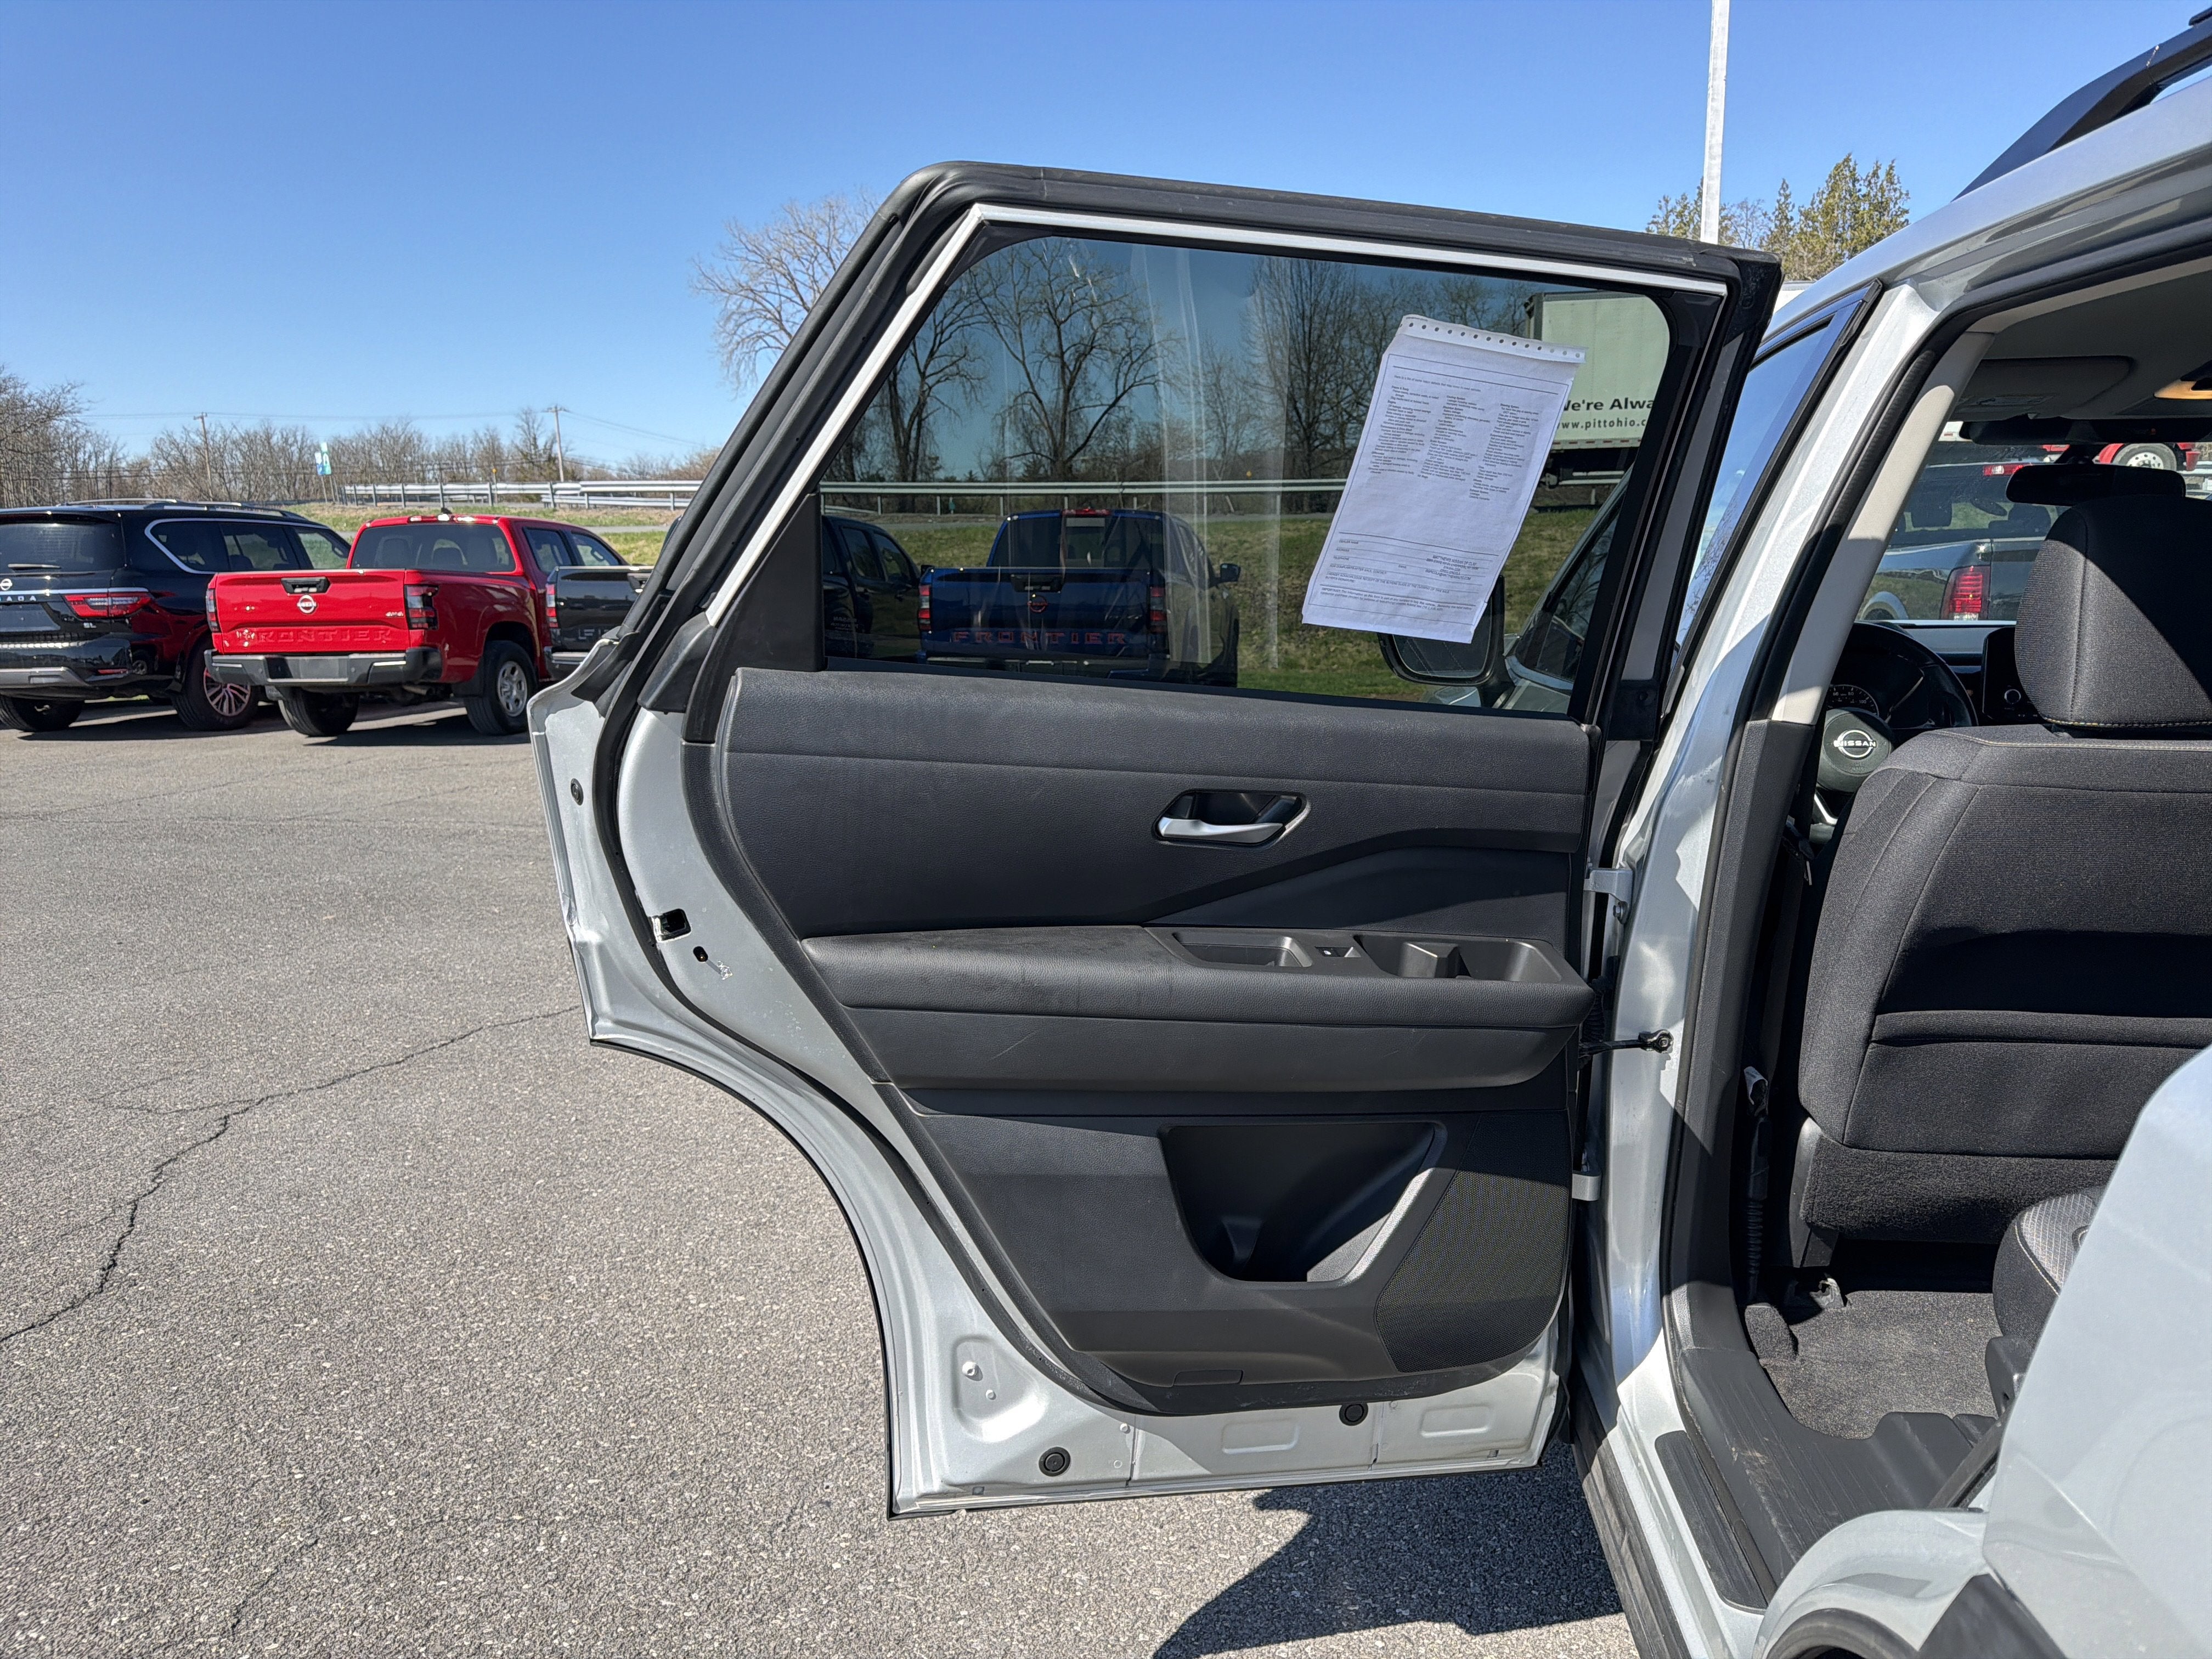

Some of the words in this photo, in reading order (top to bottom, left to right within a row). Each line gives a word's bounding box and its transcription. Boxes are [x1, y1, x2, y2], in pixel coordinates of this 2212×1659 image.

[1609, 397, 1654, 410] Alwa
[1557, 417, 1646, 431] ww.pittohio.c
[953, 631, 1126, 645] FRONTIER
